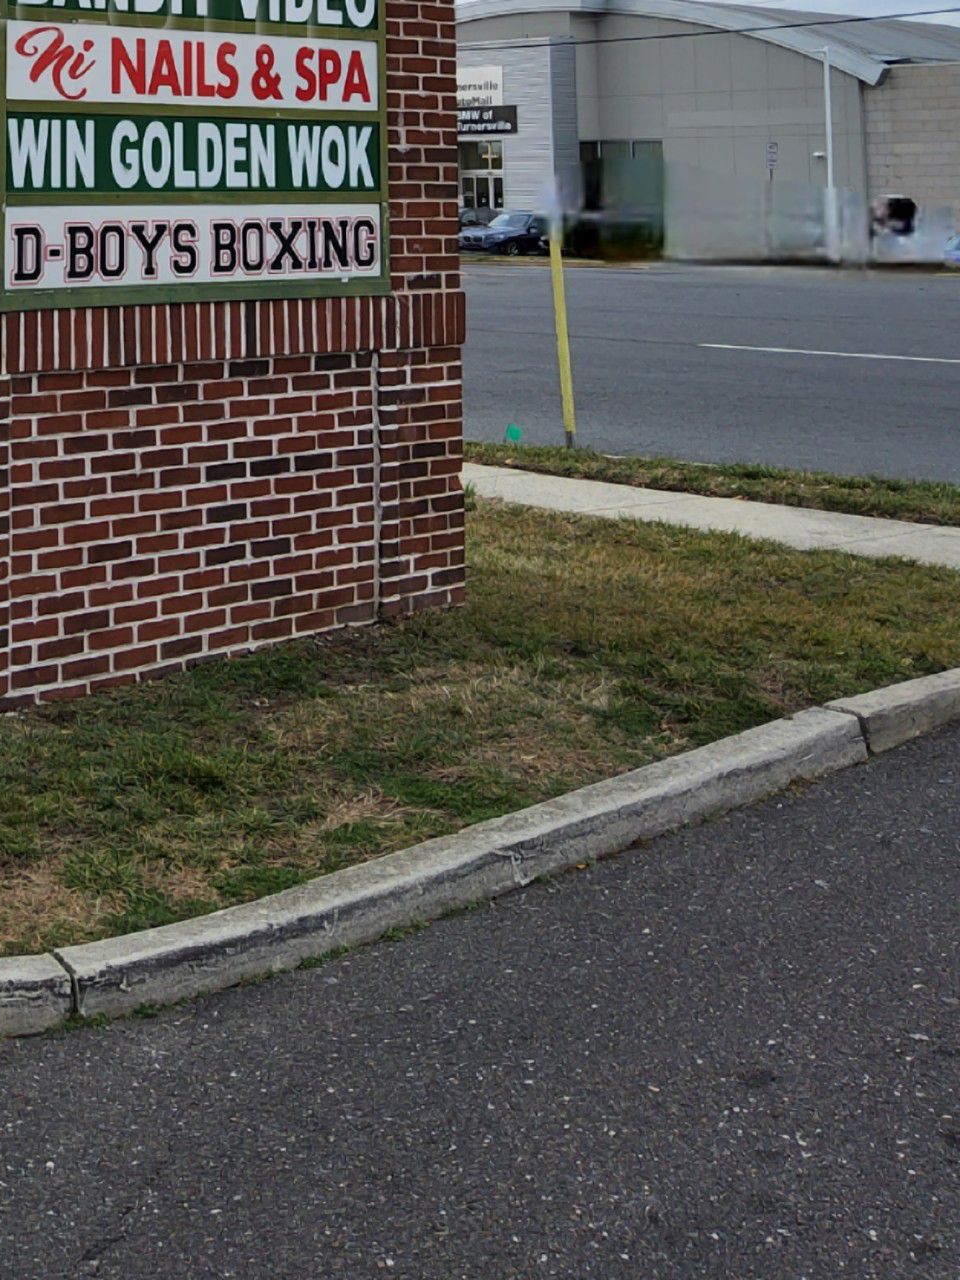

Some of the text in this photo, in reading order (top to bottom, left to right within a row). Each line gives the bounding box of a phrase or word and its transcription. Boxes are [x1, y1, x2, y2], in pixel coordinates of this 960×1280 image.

[111, 37, 239, 99] NAILS
[250, 43, 284, 100] &
[294, 46, 372, 103] SPA
[7, 118, 375, 189] WIN GOLDEN WOK
[11, 216, 379, 284] D-BOYS BOXING
